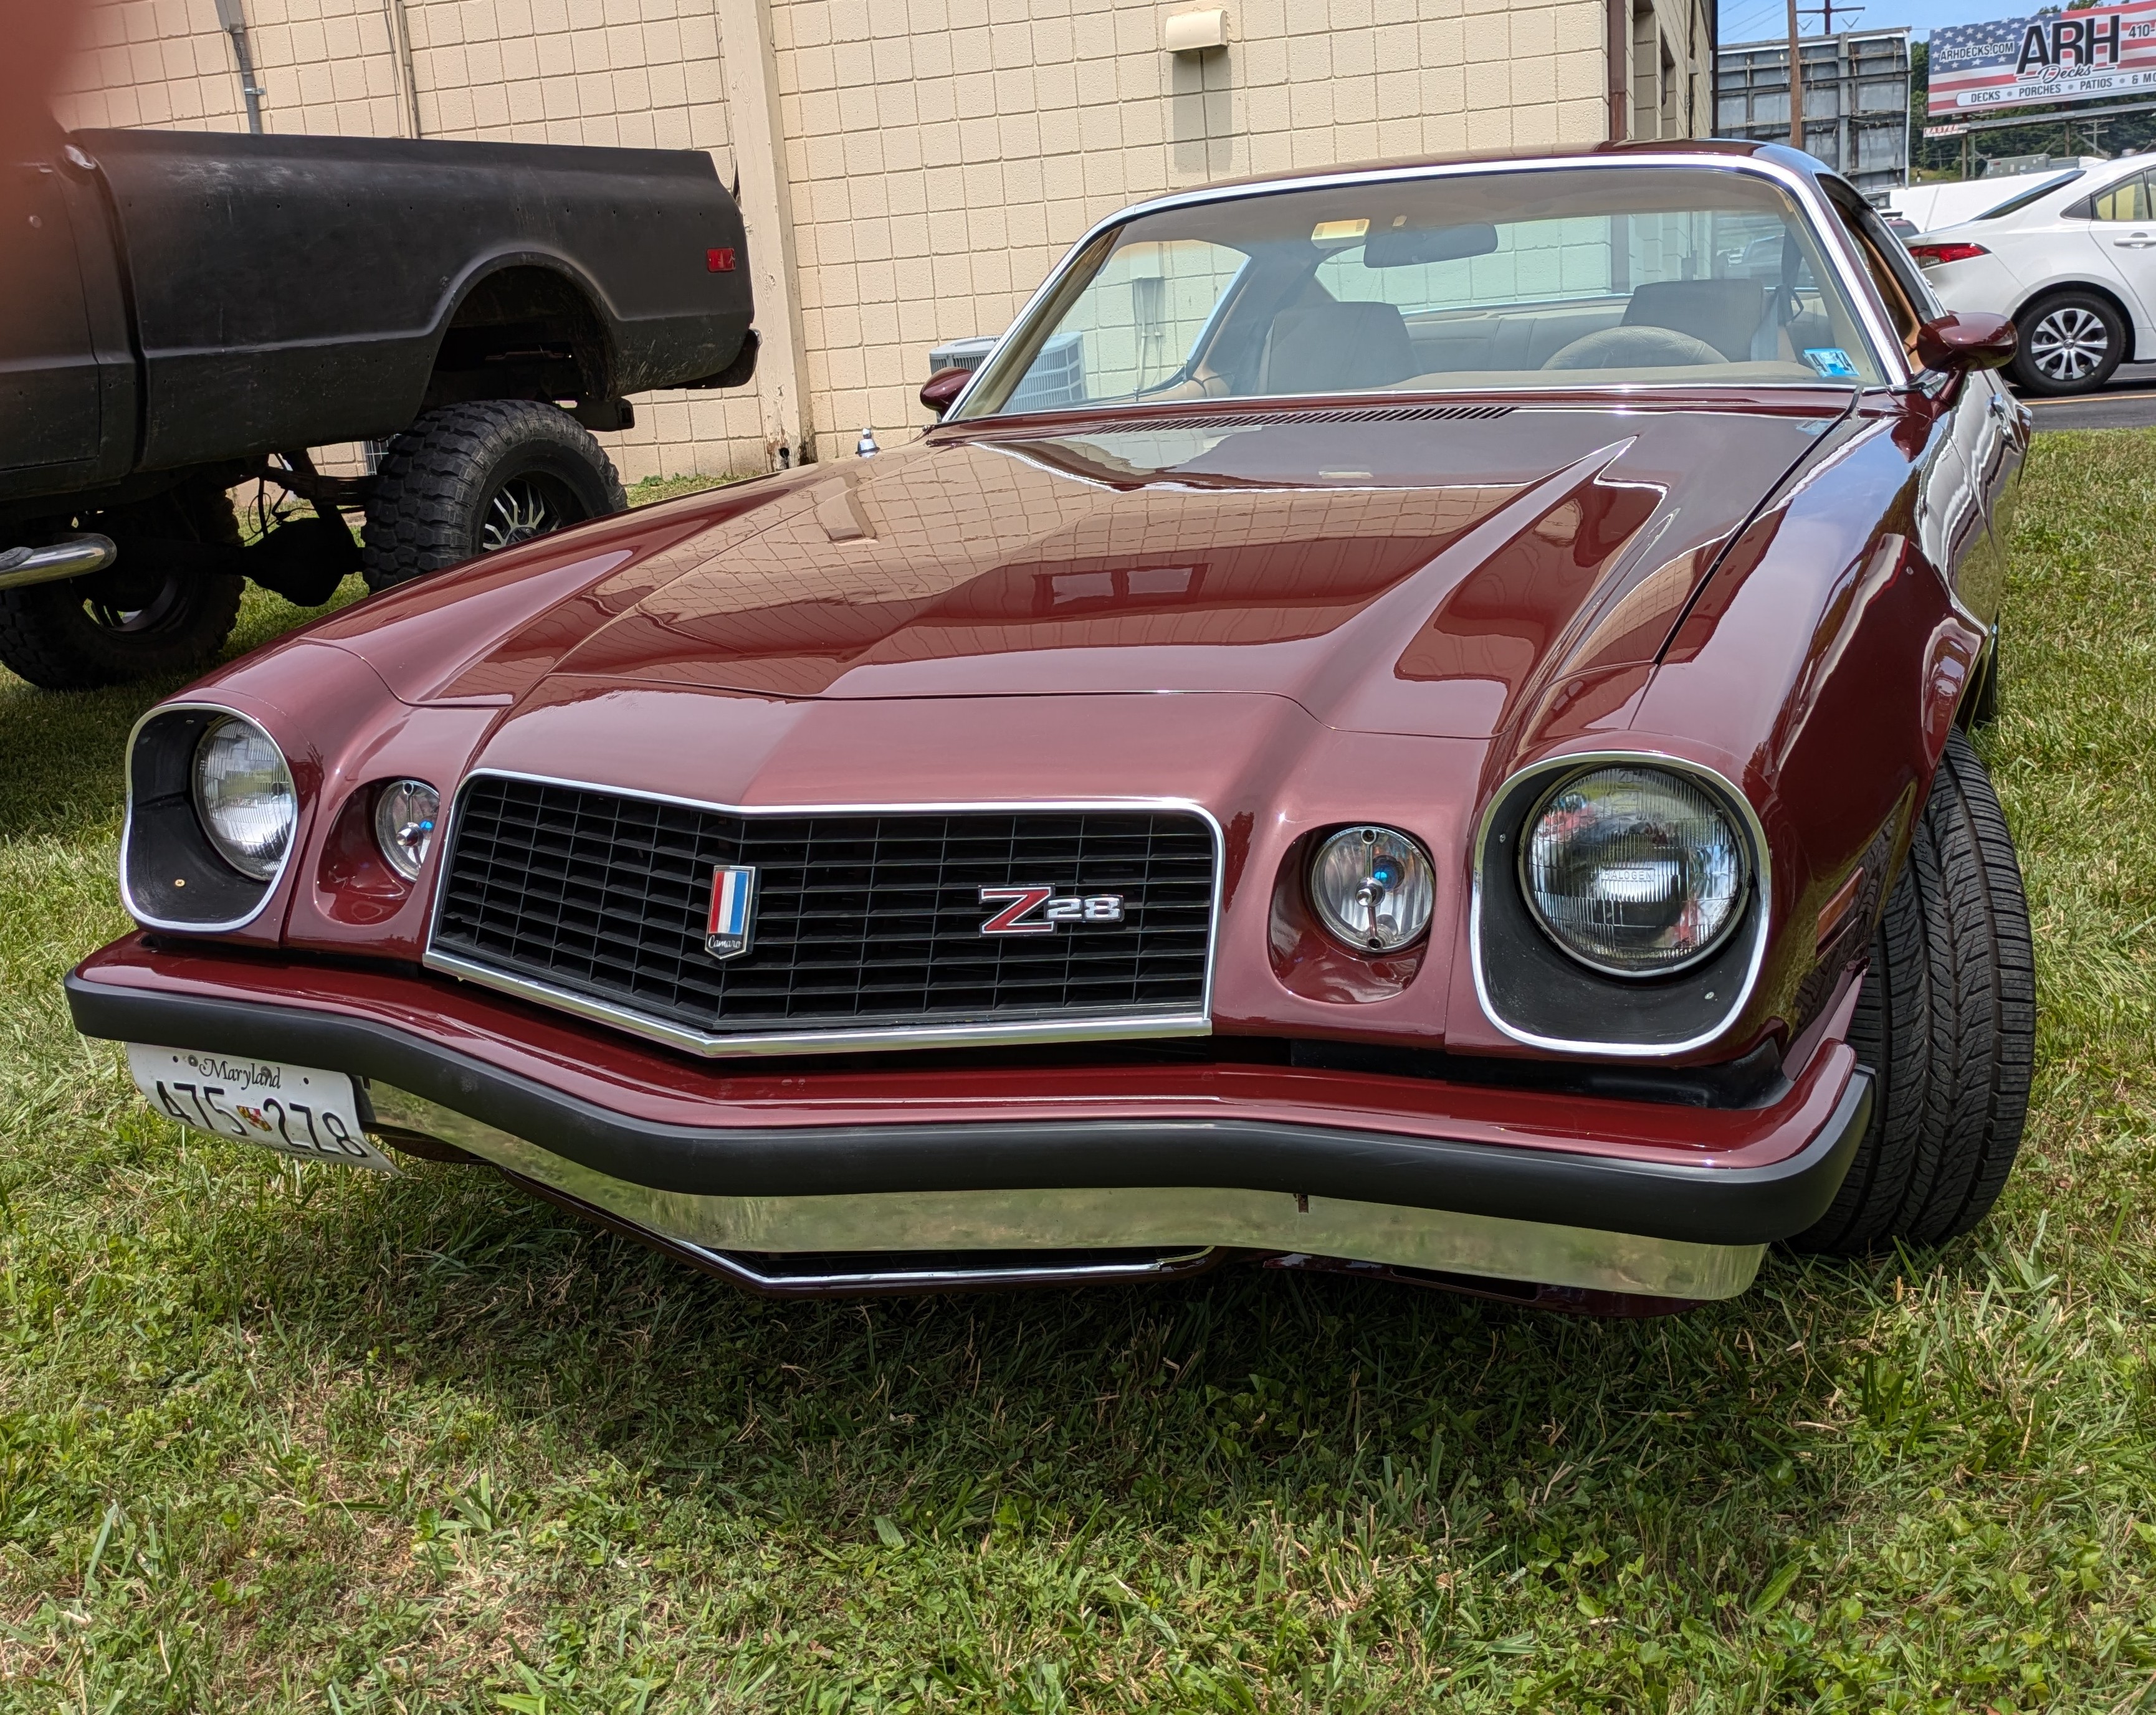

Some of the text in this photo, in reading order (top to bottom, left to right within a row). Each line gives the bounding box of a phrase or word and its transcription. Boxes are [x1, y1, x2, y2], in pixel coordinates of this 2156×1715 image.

[1940, 42, 2013, 60] ARHDECKS.COM
[2016, 15, 2120, 74] ARH
[2038, 64, 2091, 83] Decks
[1971, 90, 2000, 103] DECKS
[2019, 83, 2061, 97] PORCHES
[2080, 78, 2112, 90] PATIOS
[2132, 75, 2138, 84] &
[1601, 870, 1652, 880] HALOGEN
[980, 886, 1122, 935] Z28
[708, 934, 742, 948] Camaro
[199, 1058, 281, 1090] Maryland
